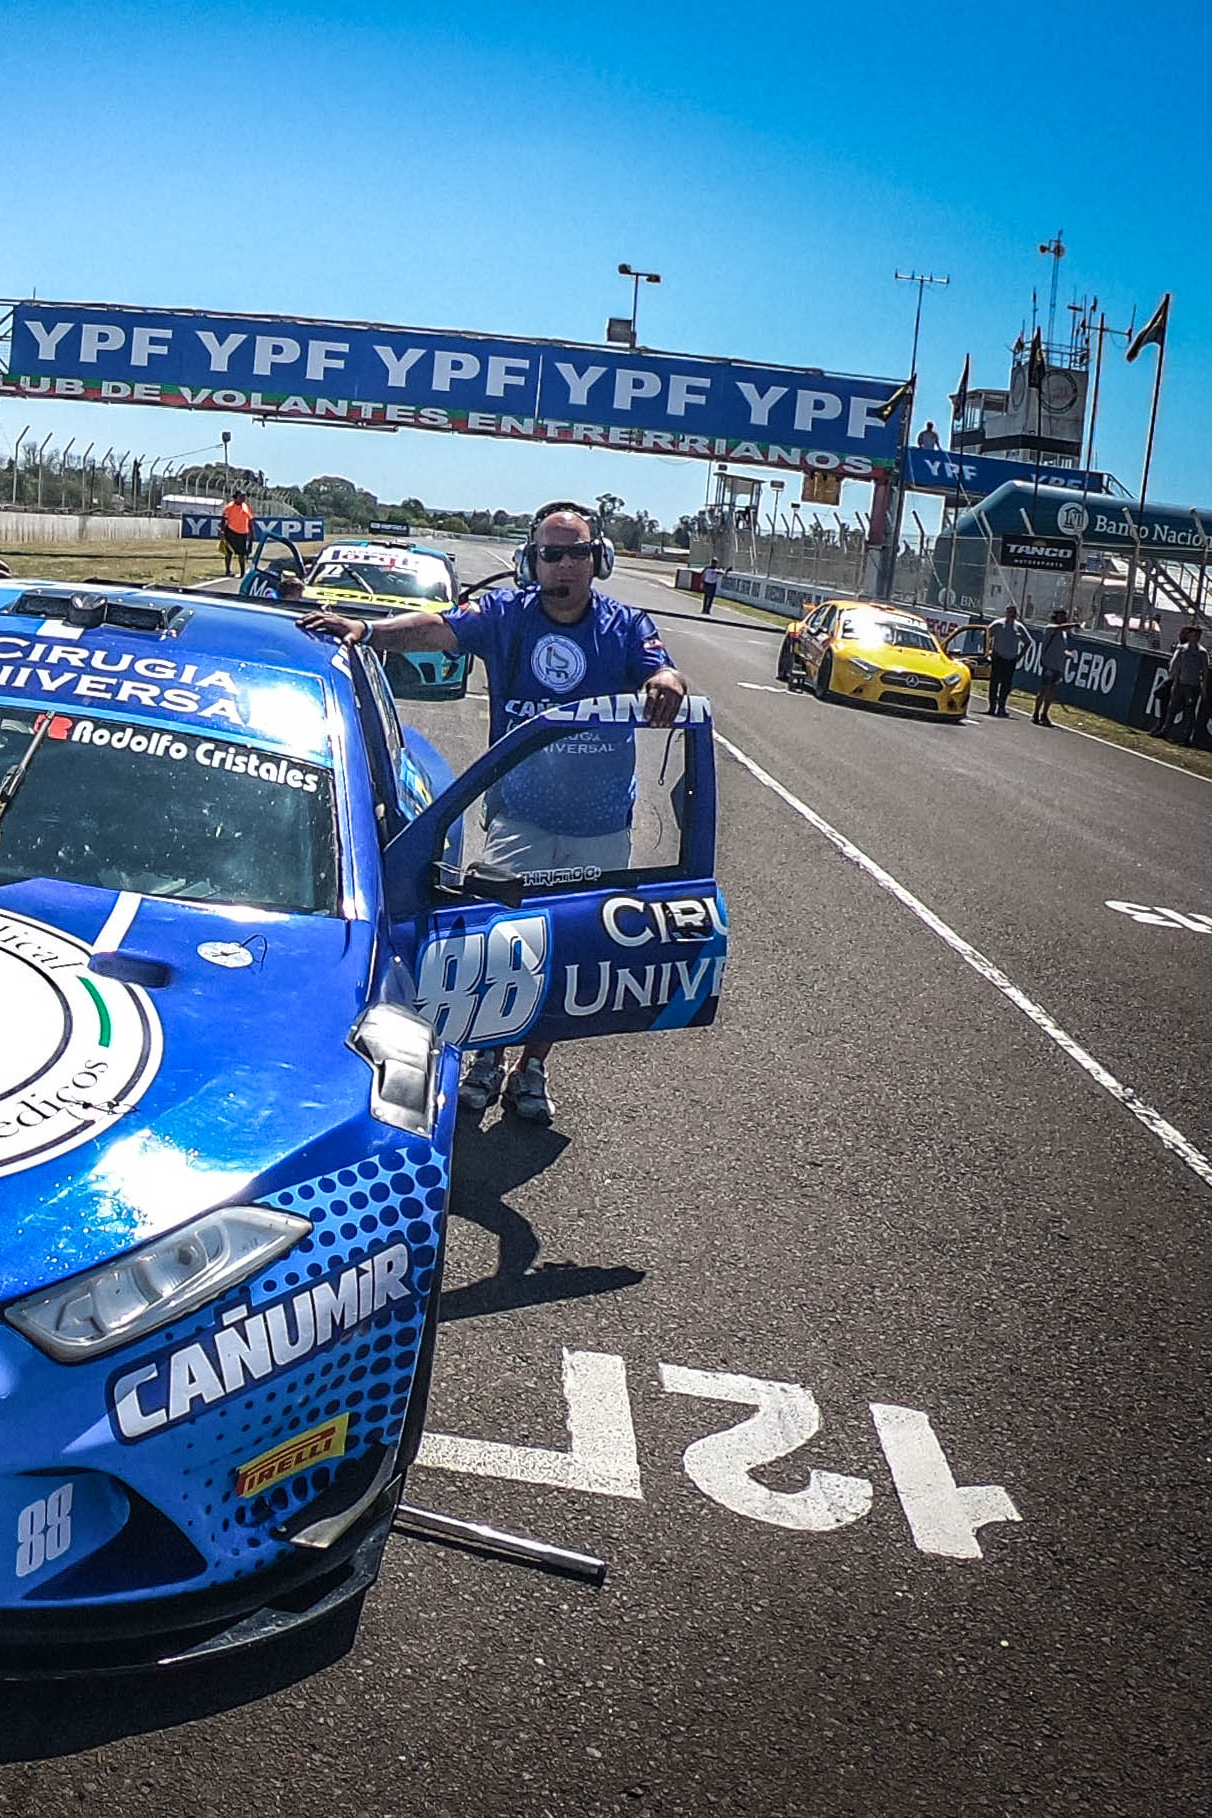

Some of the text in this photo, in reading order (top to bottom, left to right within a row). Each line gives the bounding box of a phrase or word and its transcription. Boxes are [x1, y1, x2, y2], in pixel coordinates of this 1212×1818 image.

[23, 321, 888, 438] YPF YPF YPF YPF YPF
[101, 381, 162, 400] DE
[179, 387, 453, 428] VOLANTES
[467, 413, 873, 474] ENTRERRIANOS
[924, 459, 978, 480] YPF
[185, 518, 322, 539] YP YPF
[1007, 544, 1073, 558] TANCO
[71, 720, 319, 793] Rodolfo Cristales
[413, 916, 547, 1046] 88
[113, 1243, 412, 1439] CAÑUMIR
[236, 1426, 336, 1497] PIRELLI
[16, 1482, 74, 1578] 88
